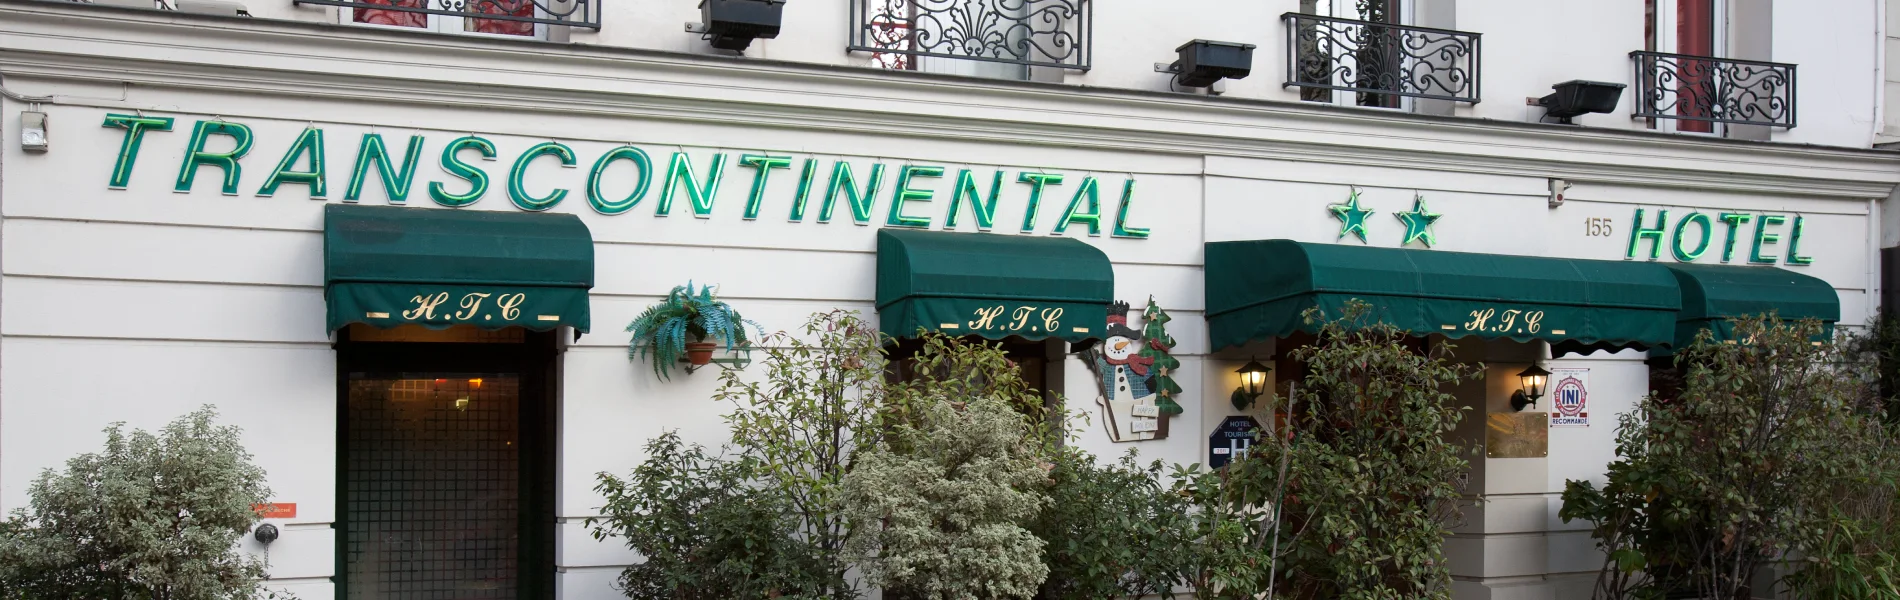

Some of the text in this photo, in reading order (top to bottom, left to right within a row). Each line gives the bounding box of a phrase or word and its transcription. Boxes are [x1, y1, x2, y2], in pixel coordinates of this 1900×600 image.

[102, 112, 1151, 240] TRANSCONTINENTAL
[1584, 216, 1613, 237] 155
[1624, 208, 1816, 266] HOTEL
[402, 291, 526, 321] H.T.C
[968, 305, 1064, 332] H.T.C
[1464, 308, 1544, 334] H.T.C
[1562, 389, 1579, 405] INI
[1231, 439, 1250, 463] H
